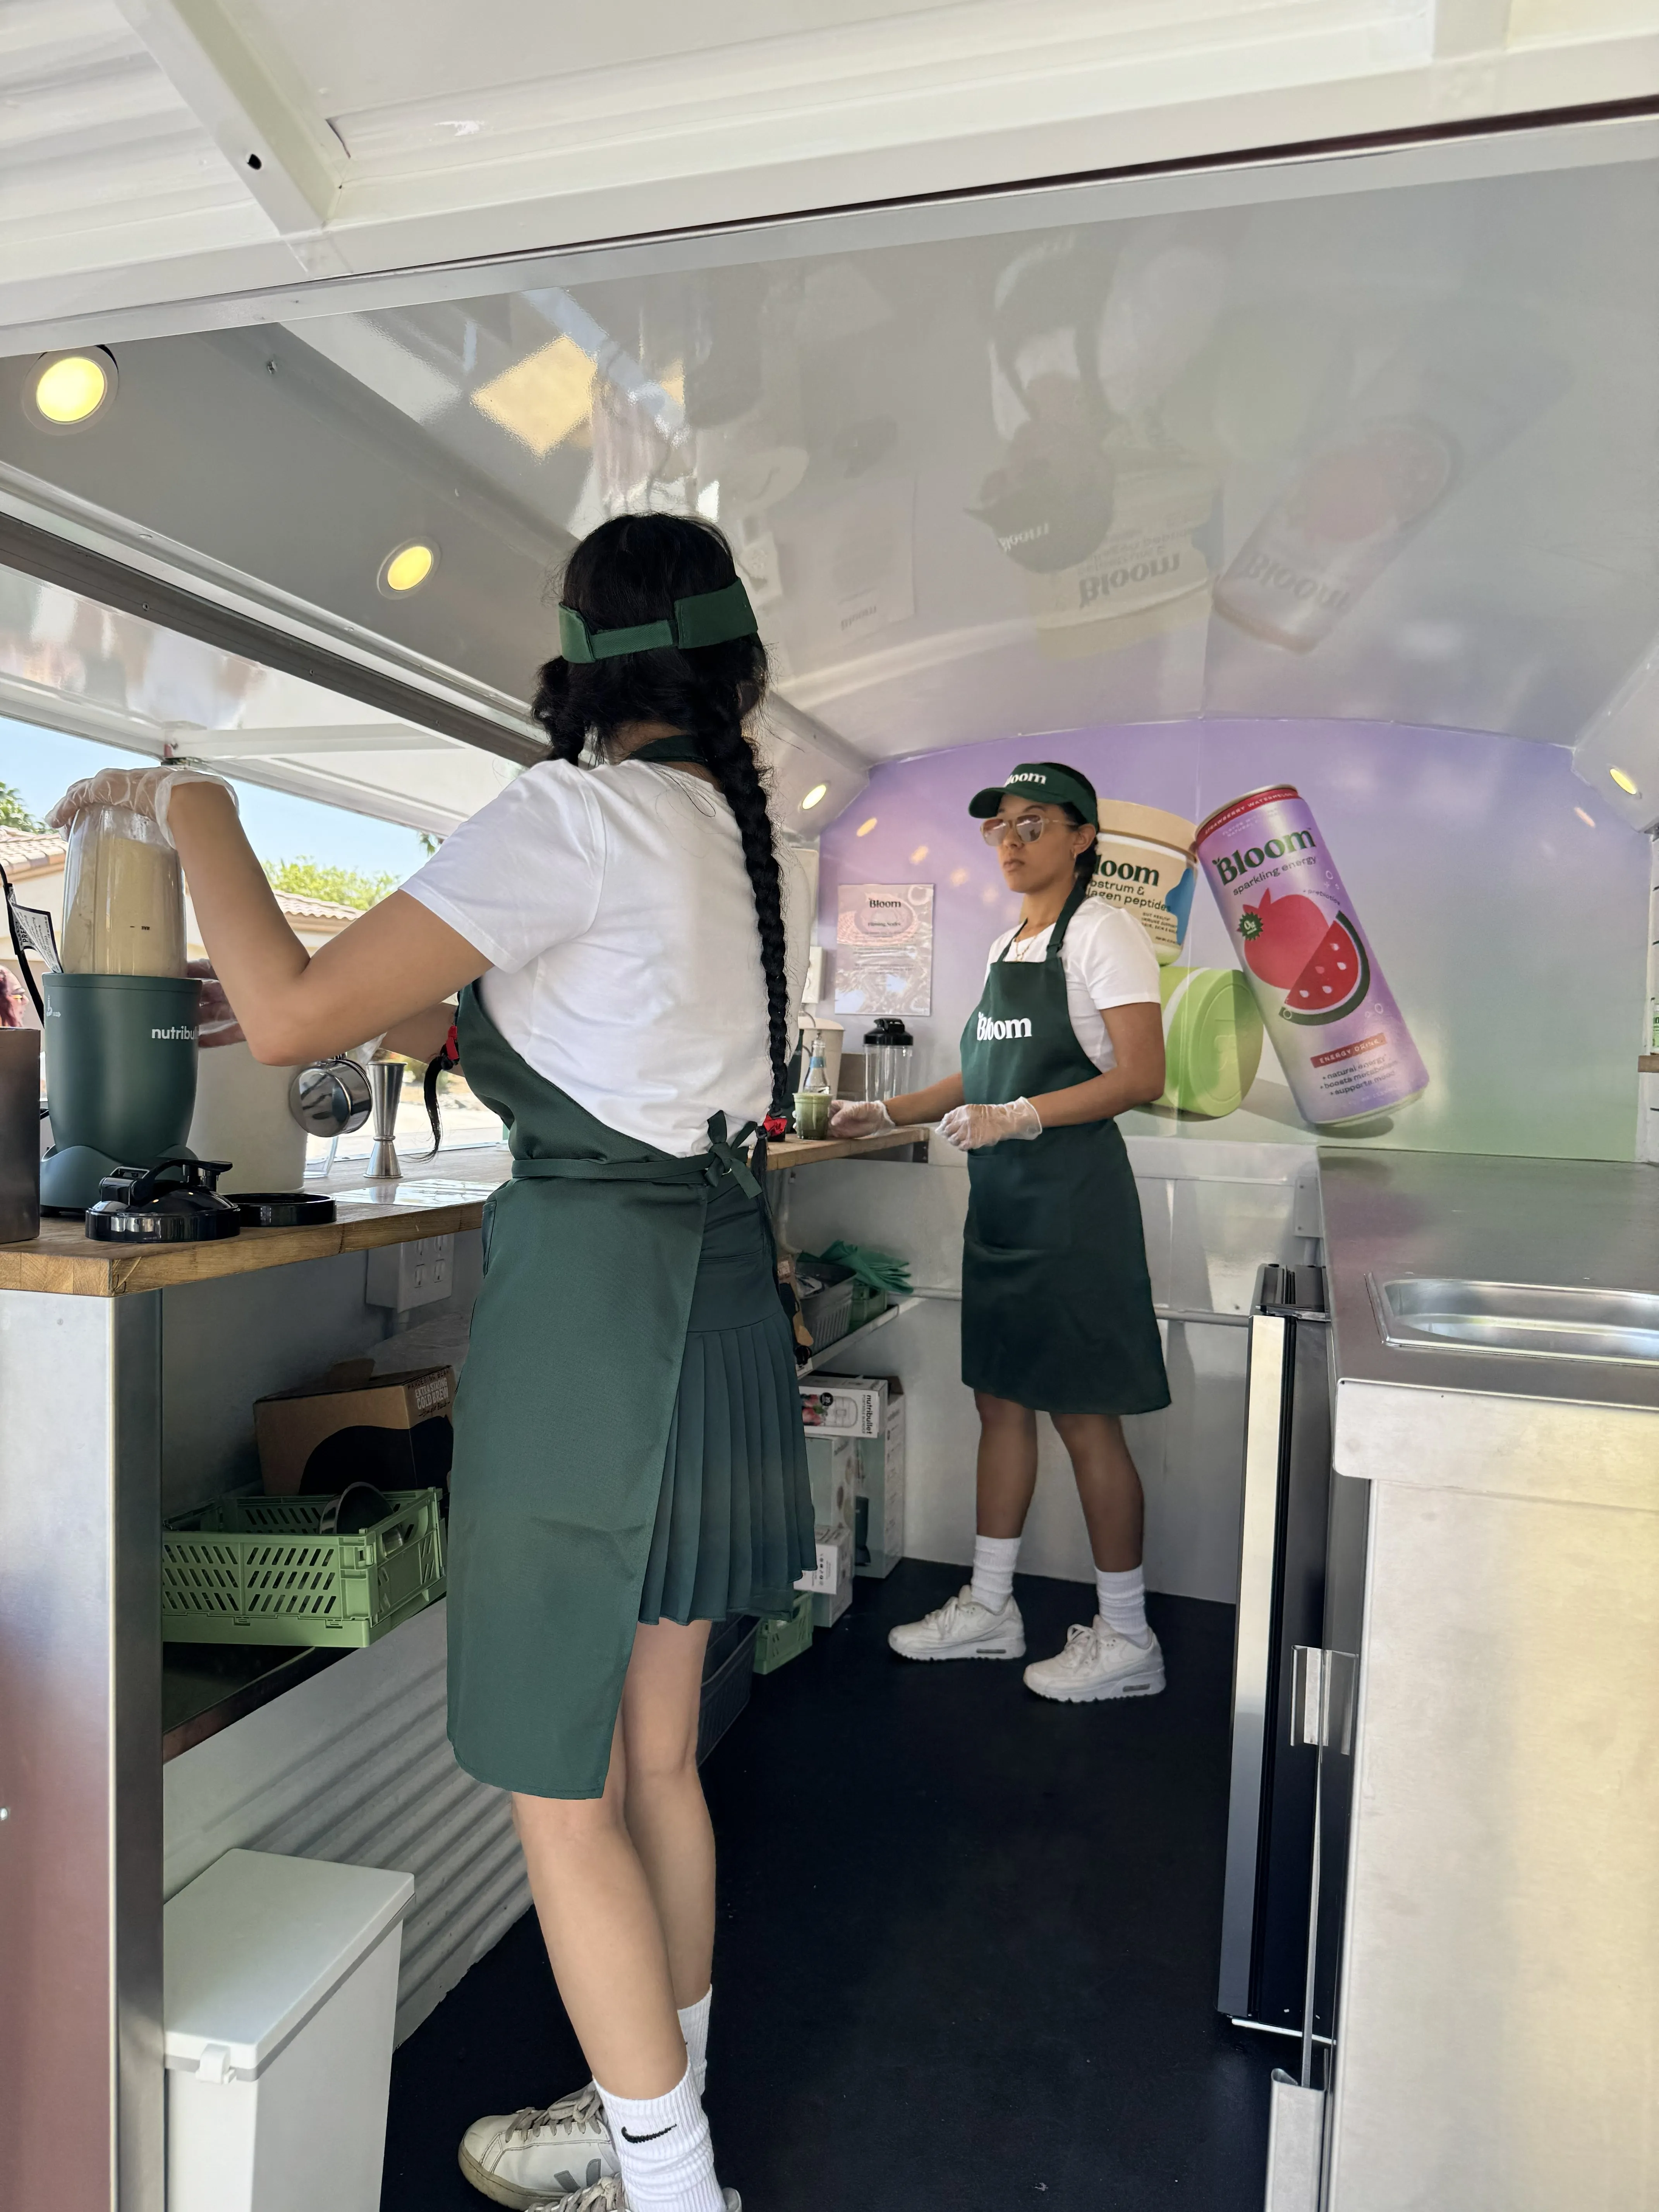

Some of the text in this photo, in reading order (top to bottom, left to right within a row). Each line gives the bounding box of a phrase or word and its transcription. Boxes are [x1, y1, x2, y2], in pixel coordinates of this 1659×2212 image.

[1003, 773, 1046, 788] loom
[1212, 830, 1316, 886] Bloom
[1094, 854, 1159, 887] loom
[1233, 856, 1316, 896] sparkling energy
[1090, 880, 1145, 895] ostrum &
[868, 898, 902, 908] Bloom
[1087, 887, 1171, 913] lagen peptides
[152, 1025, 194, 1040] nutribu
[977, 1012, 1032, 1041] Bloom
[1319, 1039, 1380, 1064] ENERGY DRINK
[1324, 1077, 1352, 1089] boosts
[1327, 1065, 1357, 1080] natural
[415, 1377, 448, 1399] EXTRA STRONG
[417, 1386, 449, 1410] COLD BREW
